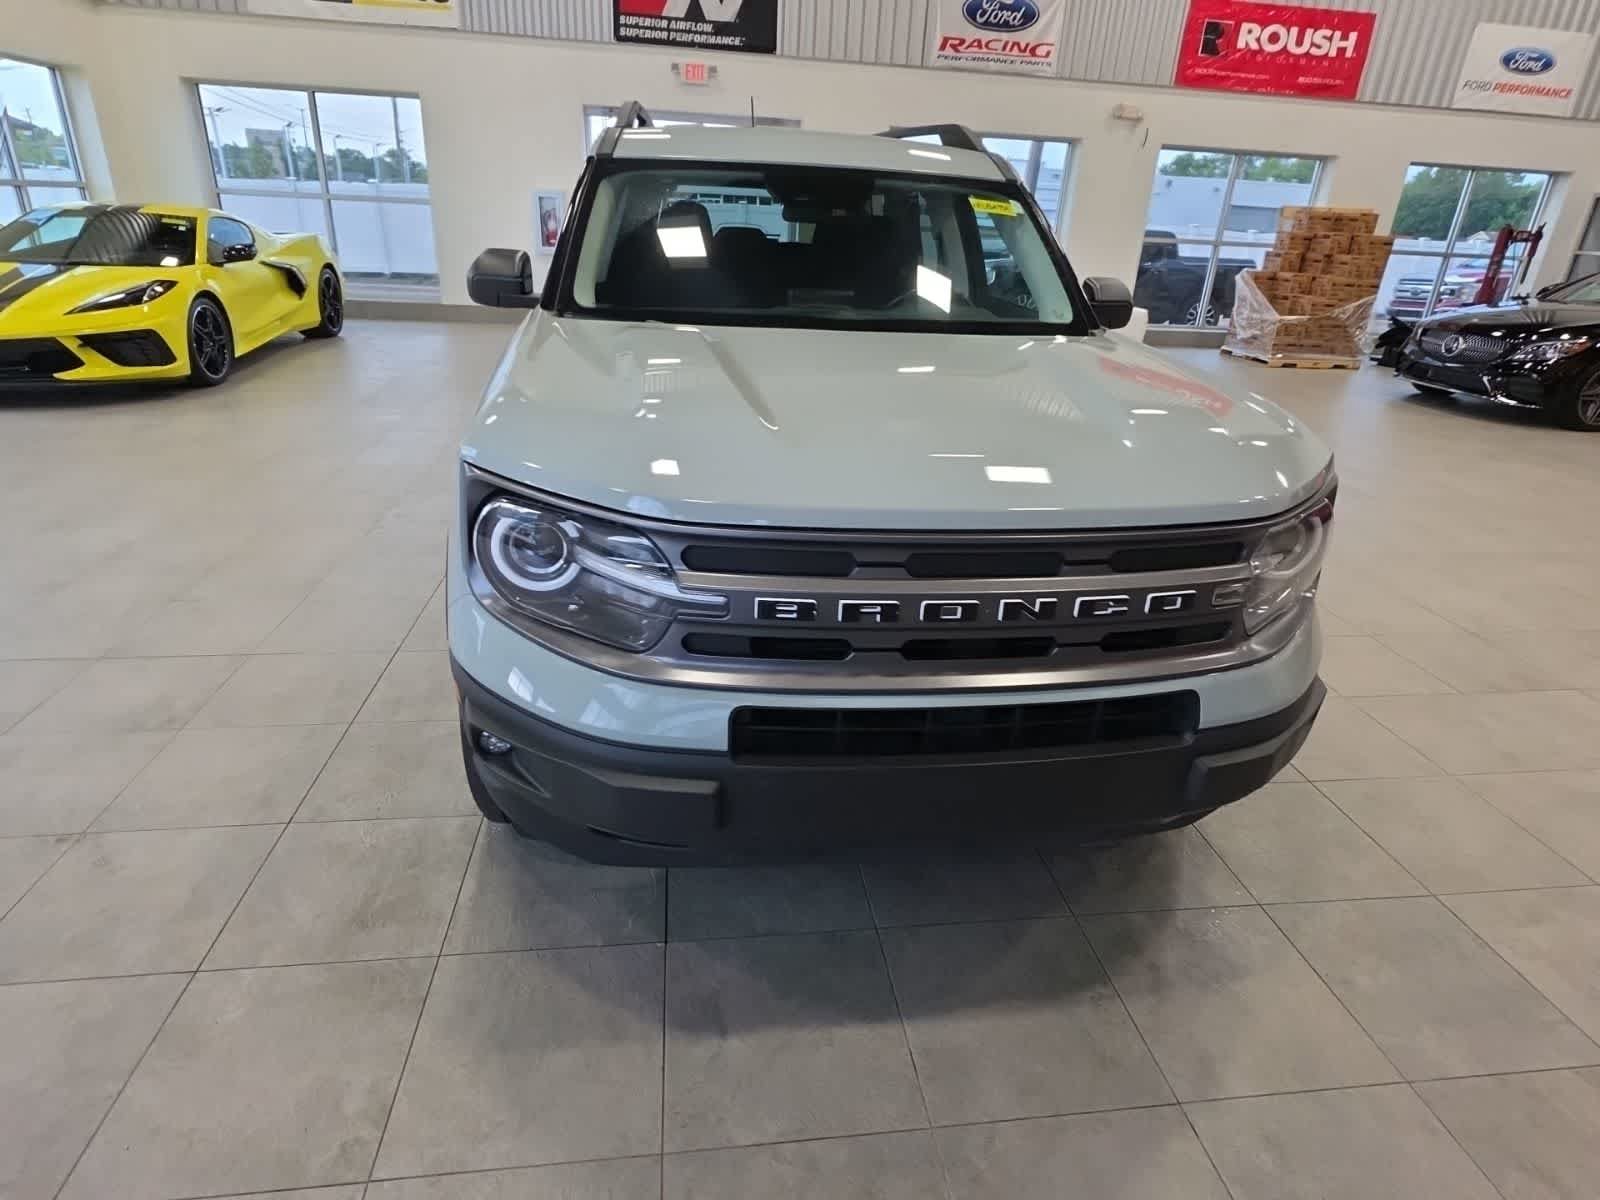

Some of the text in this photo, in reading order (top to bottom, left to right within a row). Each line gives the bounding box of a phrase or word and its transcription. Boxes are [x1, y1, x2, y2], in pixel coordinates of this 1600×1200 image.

[976, 0, 1025, 26] Ford
[619, 15, 715, 33] SUPERIOR AIRFLOW.
[619, 27, 669, 40] SUPERIOR
[938, 36, 1055, 58] RACING
[1237, 22, 1358, 58] ROUSH
[937, 54, 1017, 65] PERFORMANCE
[1509, 51, 1547, 72] Ford
[685, 63, 705, 81] EXIT
[1462, 79, 1574, 99] FORD PERFORMANCE
[753, 589, 1198, 623] BRONCO
